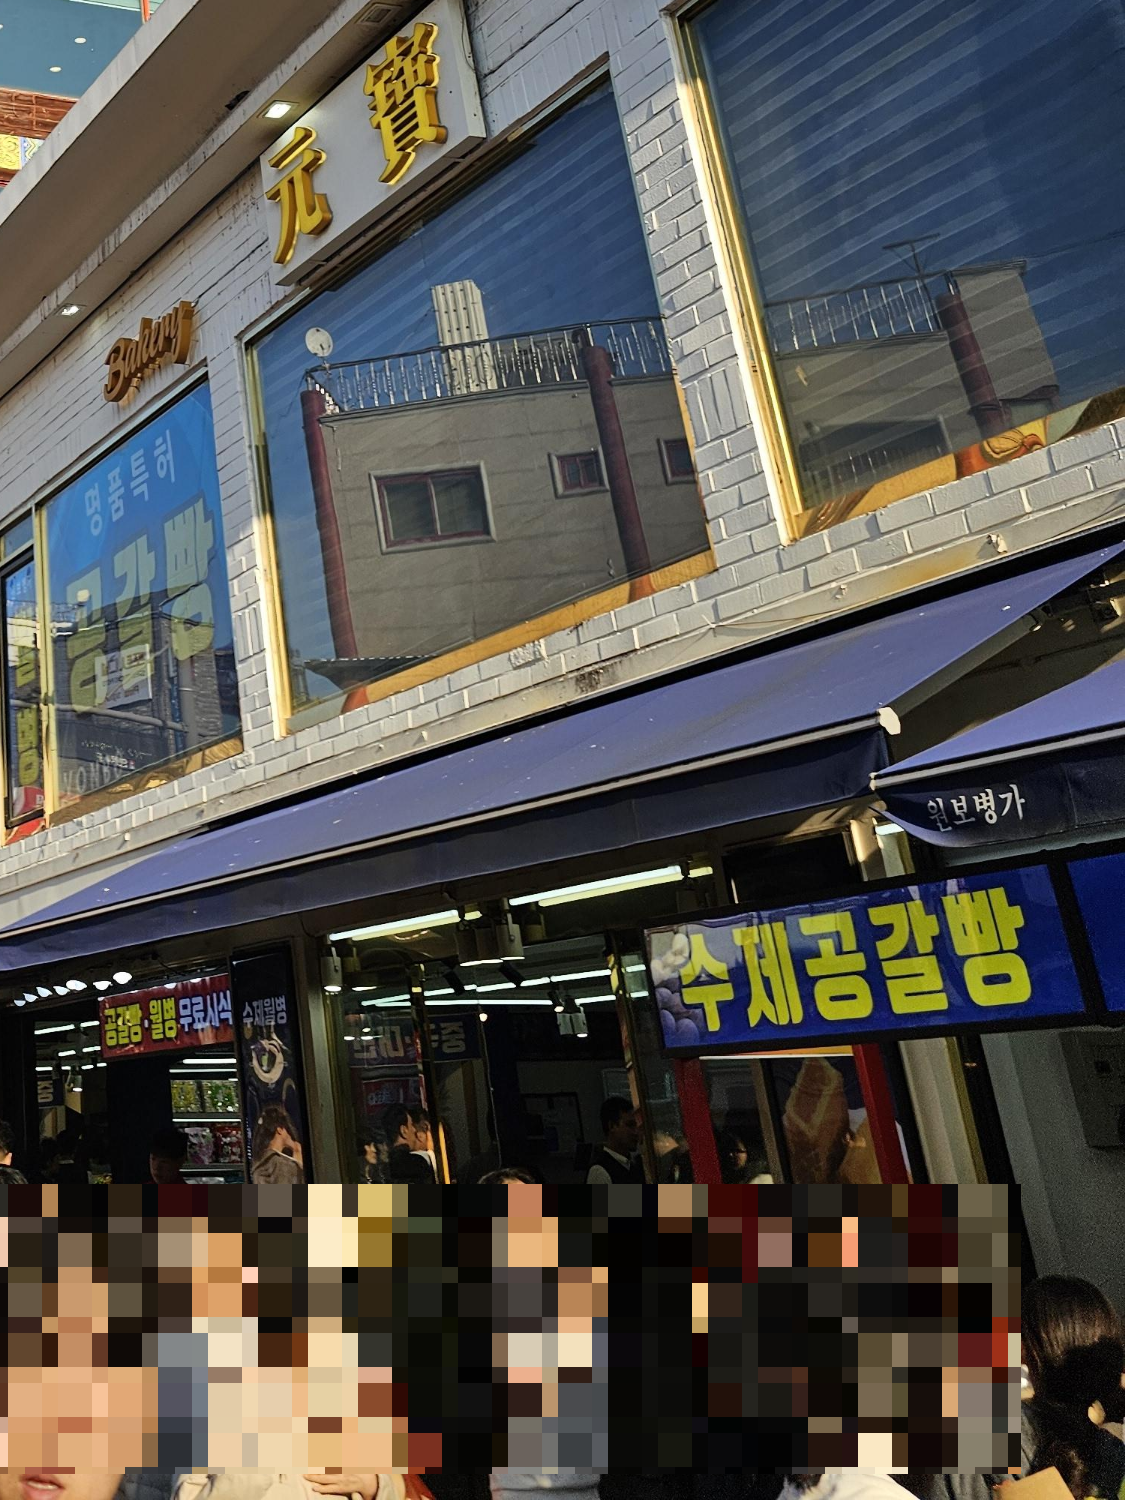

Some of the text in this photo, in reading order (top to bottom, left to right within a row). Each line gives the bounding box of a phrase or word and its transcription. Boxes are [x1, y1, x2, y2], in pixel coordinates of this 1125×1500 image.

[103, 300, 195, 404] Bakery
[927, 784, 1025, 832] 원보병가
[680, 886, 1033, 1033] 수제공갈빵
